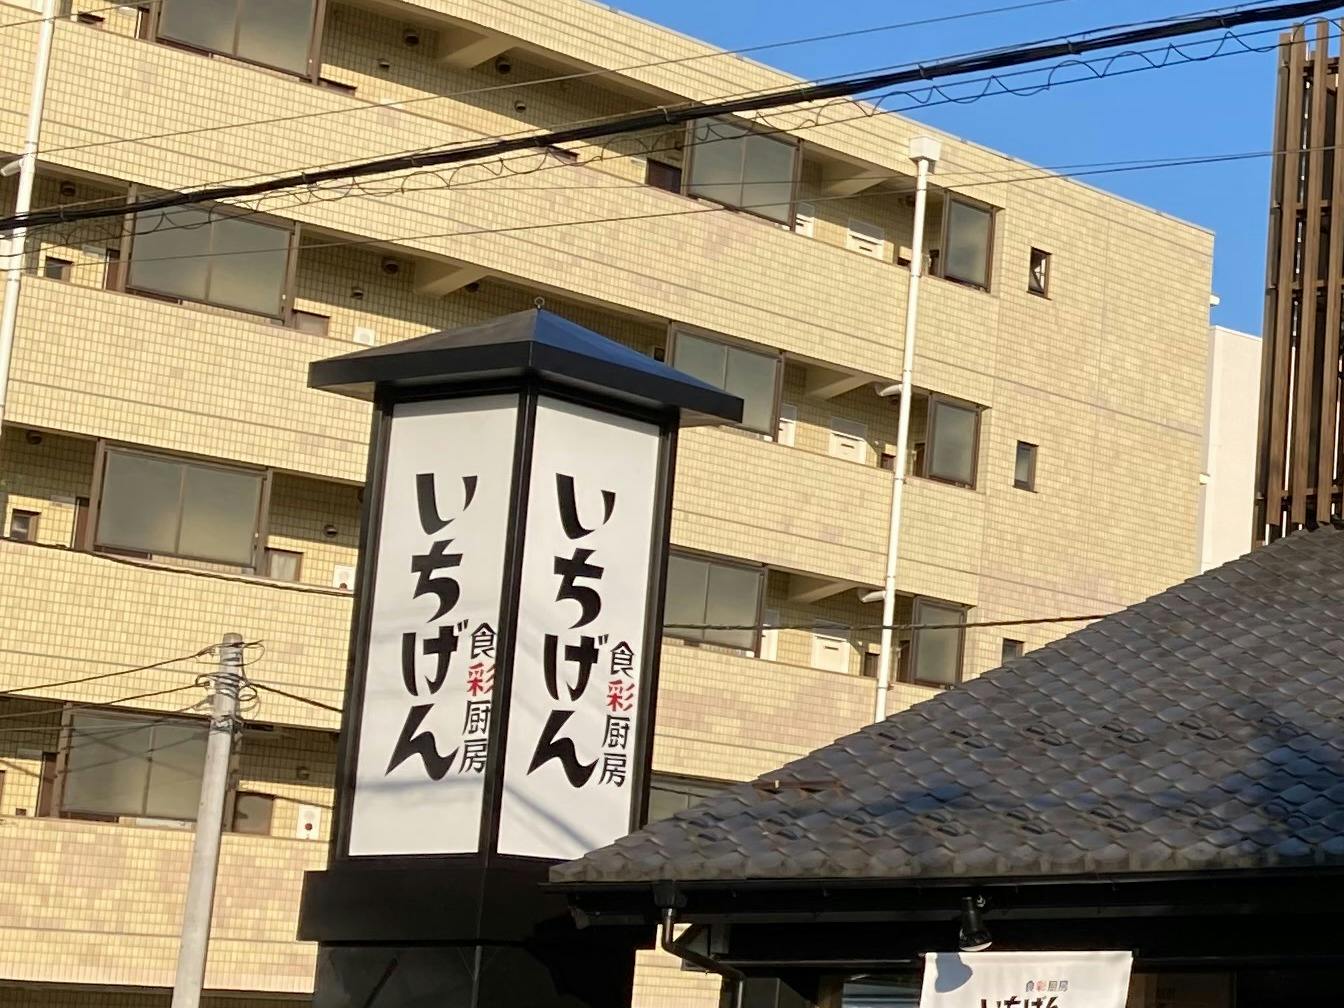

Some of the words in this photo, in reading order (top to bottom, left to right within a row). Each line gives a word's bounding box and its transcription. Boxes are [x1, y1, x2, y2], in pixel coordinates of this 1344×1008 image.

[385, 472, 478, 781] いちげん
[458, 621, 497, 776] 食彩厨房
[526, 472, 616, 788] いちげん
[598, 640, 635, 788] 食彩厨房
